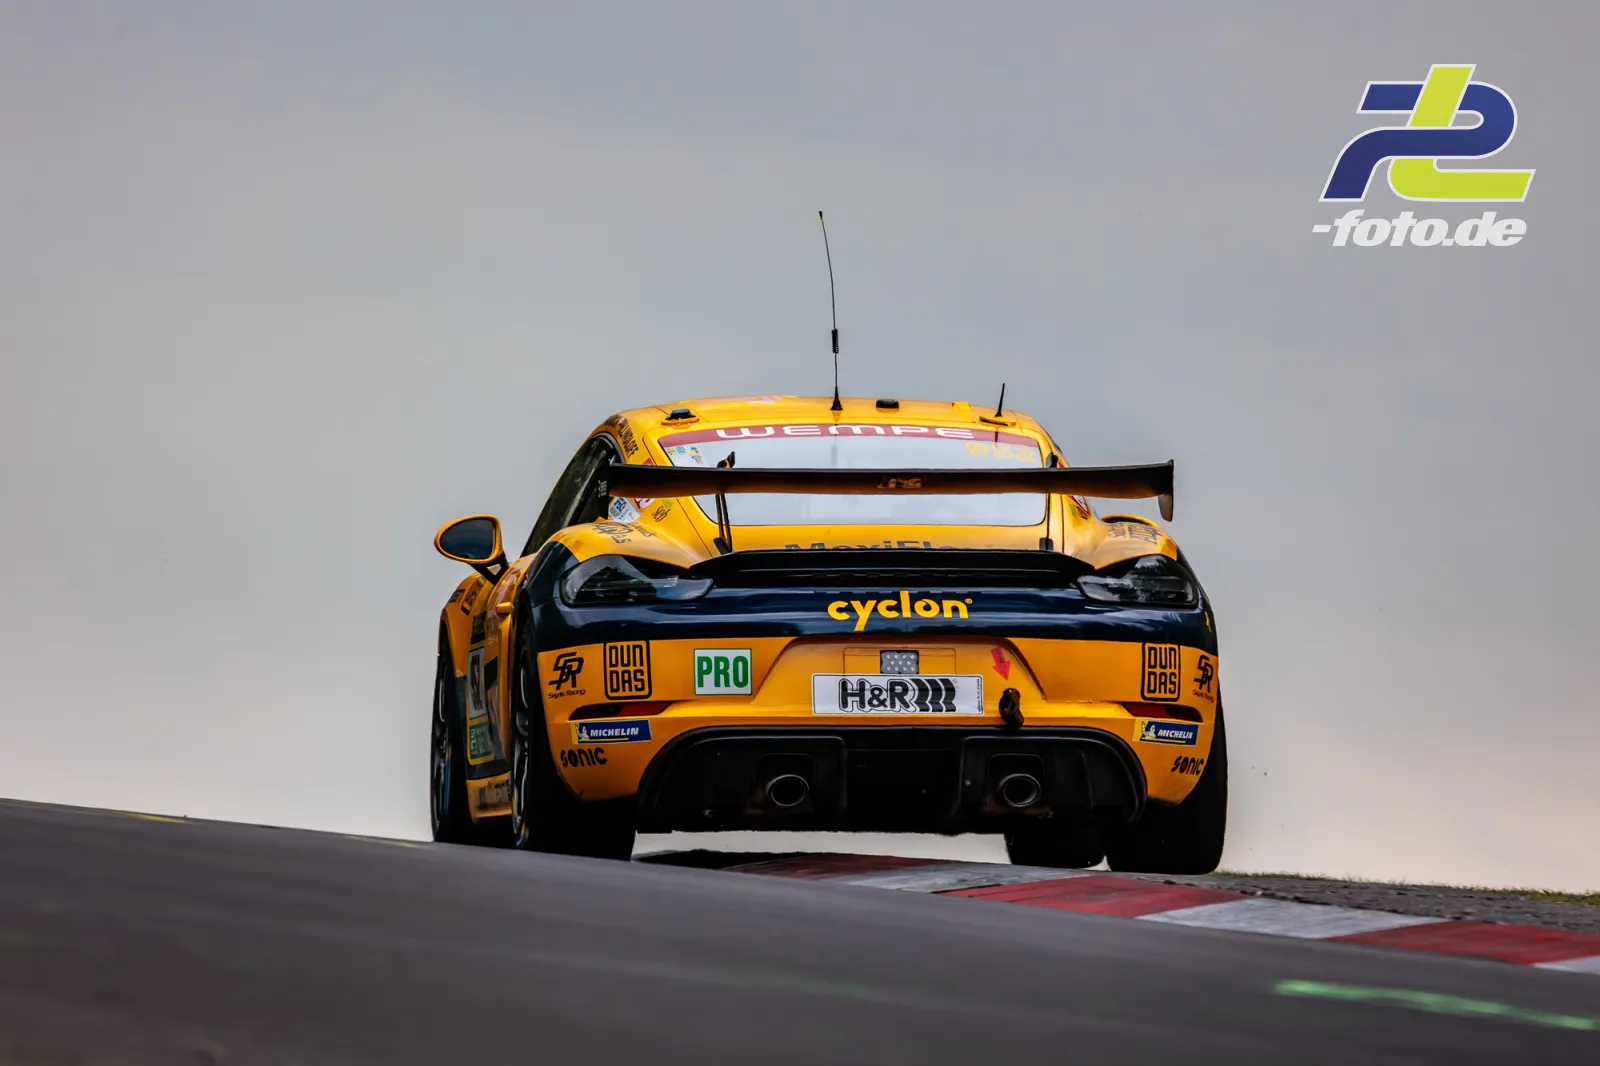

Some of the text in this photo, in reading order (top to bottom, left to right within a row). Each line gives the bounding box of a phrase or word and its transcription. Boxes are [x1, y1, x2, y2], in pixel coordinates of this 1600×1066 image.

[716, 424, 974, 439] WEMPE
[609, 645, 643, 668] DUN
[1147, 646, 1177, 669] DUN
[610, 669, 646, 692] DAS
[697, 655, 749, 688] PRO
[1146, 670, 1177, 694] DAS
[840, 679, 917, 712] H&R
[590, 727, 639, 737] MICHELIN
[1157, 729, 1193, 739] MICHELIN
